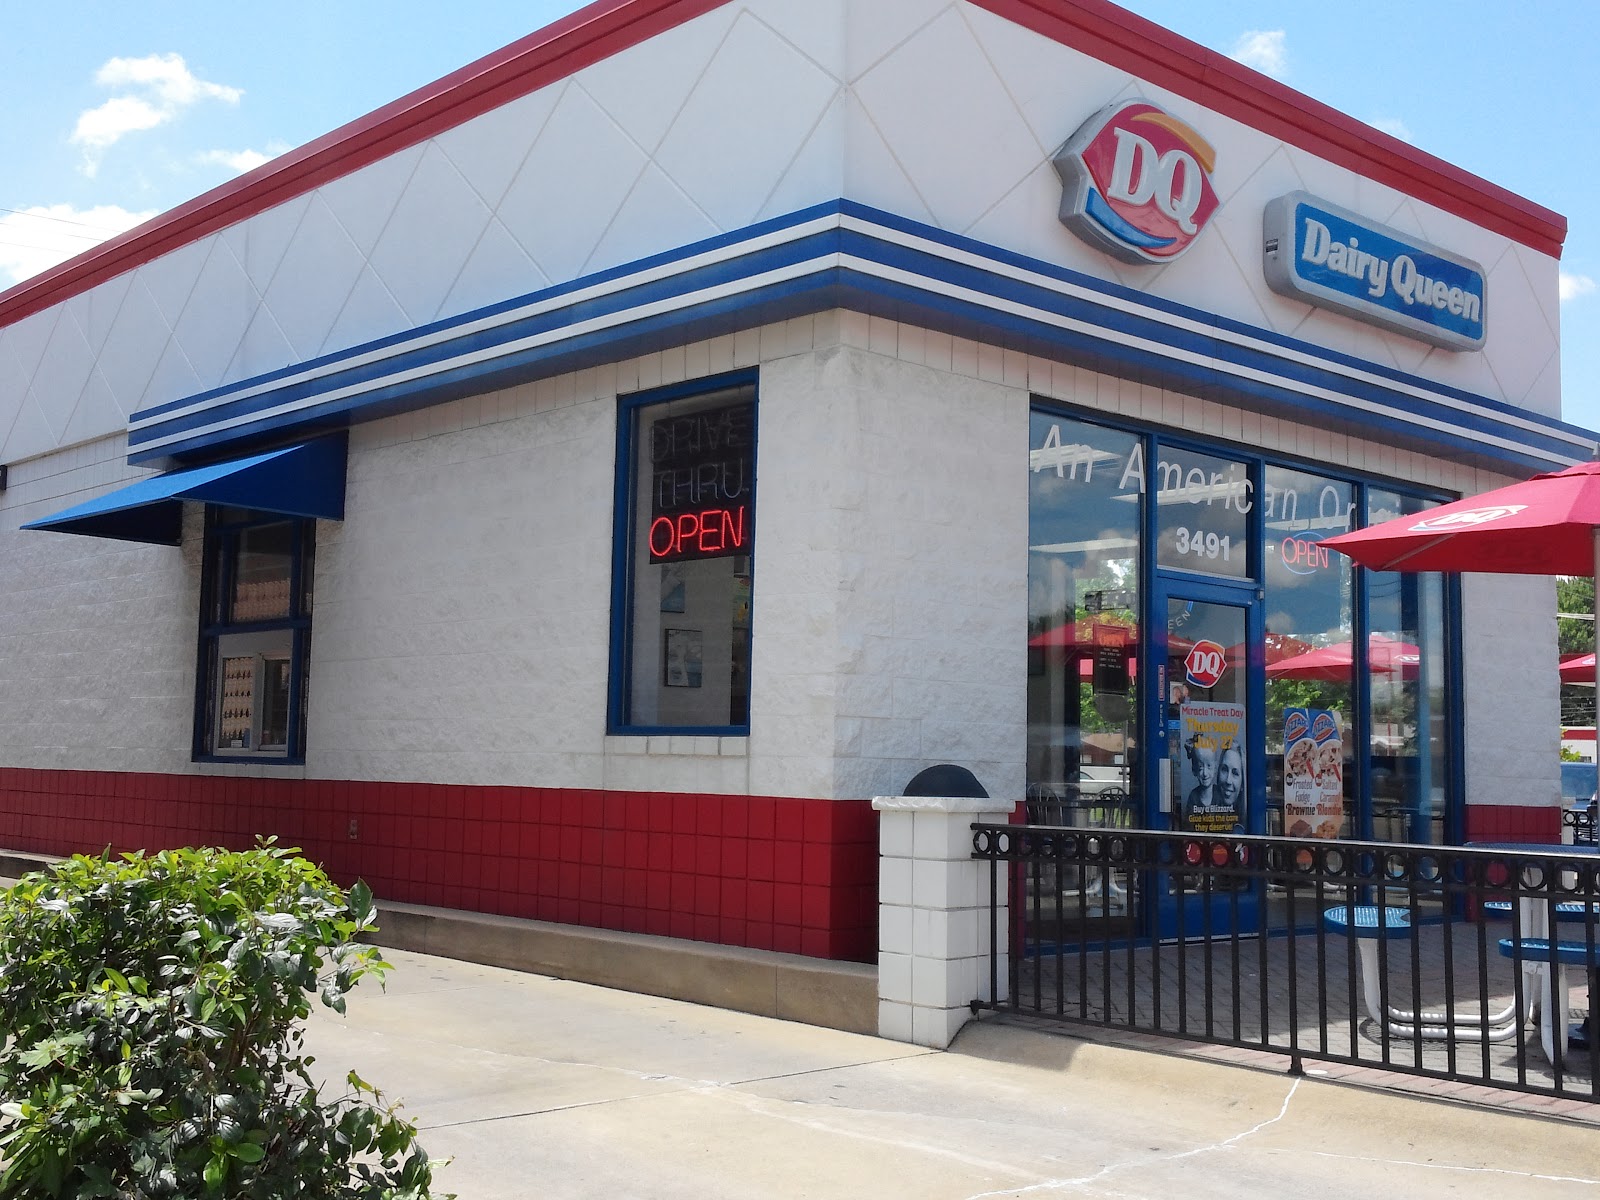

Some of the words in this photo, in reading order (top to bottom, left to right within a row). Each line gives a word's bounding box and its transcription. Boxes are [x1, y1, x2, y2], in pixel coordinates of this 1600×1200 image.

[1107, 127, 1203, 235] DQ
[1302, 217, 1389, 298] Dairy
[1391, 254, 1480, 323] Queen
[651, 408, 749, 462] DRIVE
[1033, 424, 1094, 483] An
[653, 458, 743, 508] THRU
[650, 506, 745, 557] OPEN
[1175, 526, 1231, 562] 3491
[1281, 536, 1329, 569] OPEN
[1192, 651, 1220, 678] DQ
[1181, 705, 1209, 716] Miracle
[1209, 707, 1229, 717] Treat
[1230, 708, 1245, 719] Day
[1186, 717, 1239, 737] Thursday
[1194, 735, 1218, 752] July
[1220, 735, 1233, 750] 27
[1292, 778, 1313, 790] Frosted
[1322, 779, 1338, 790] Salted
[1295, 791, 1311, 804] Fudge
[1188, 814, 1202, 822] Give
[1203, 814, 1215, 822] kids
[1193, 805, 1204, 814] Buy
[1286, 803, 1315, 816] Brownie
[1195, 823, 1208, 832] they
